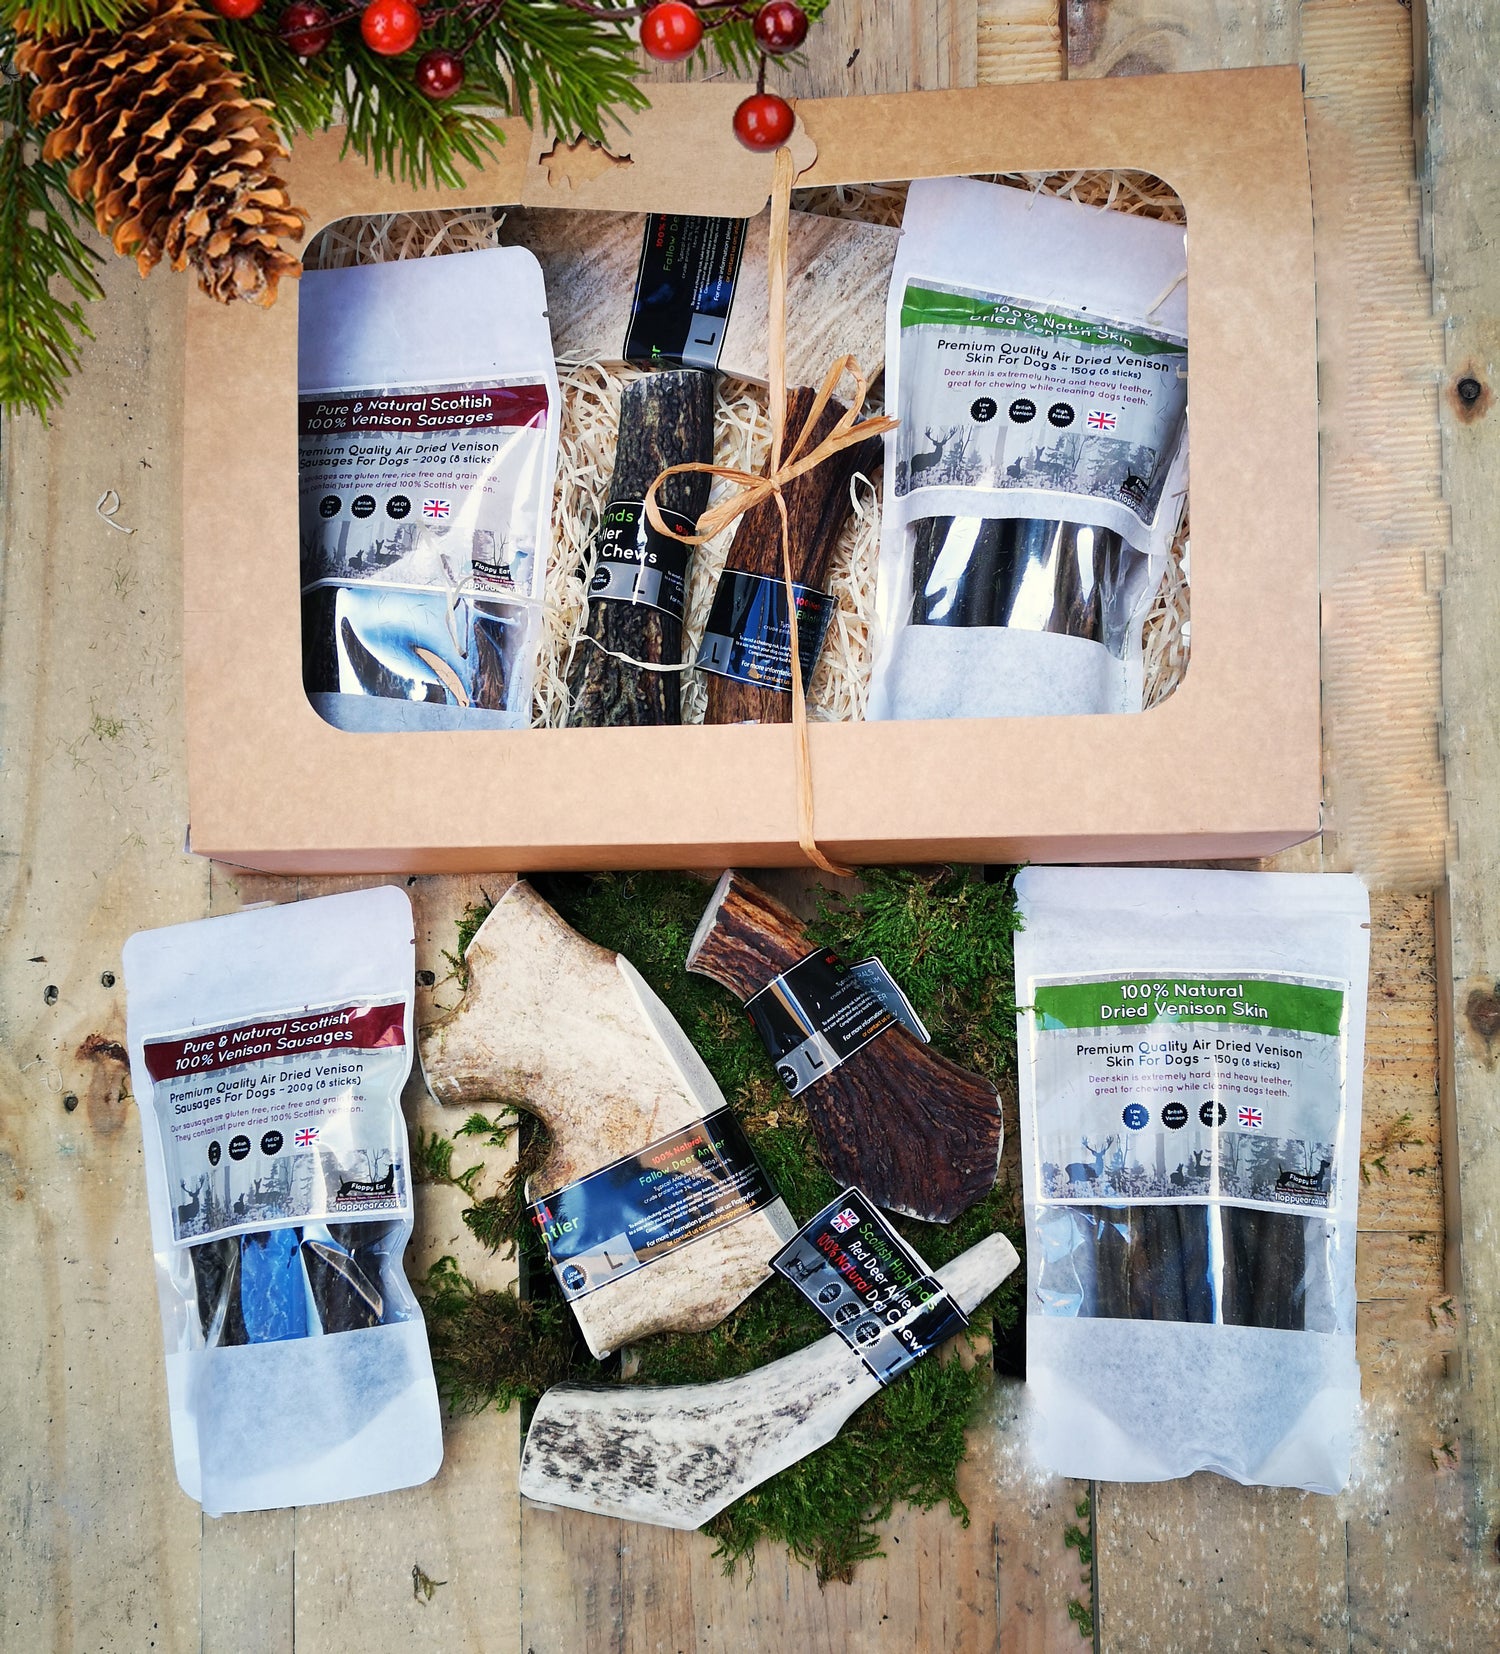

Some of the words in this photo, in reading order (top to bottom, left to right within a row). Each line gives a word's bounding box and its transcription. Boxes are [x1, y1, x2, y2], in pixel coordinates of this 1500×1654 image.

[664, 236, 675, 271] Fallow
[720, 240, 729, 274] information
[994, 305, 1038, 323] 100%
[694, 333, 716, 345] L
[1097, 329, 1132, 346] Skin
[938, 340, 996, 352] Premium
[1001, 343, 1048, 359] Quality
[1052, 350, 1070, 362] Air
[1075, 356, 1112, 365] Dried
[1117, 356, 1169, 372] Venison
[966, 352, 993, 364] Skin
[998, 354, 1019, 364] For
[1024, 356, 1056, 370] Dogs
[1071, 366, 1096, 376] 150g
[1112, 369, 1142, 380] sticks)
[944, 368, 964, 376] Deer
[997, 371, 1042, 380] extremely
[1044, 375, 1066, 384] hard
[1088, 380, 1116, 390] heavy
[1120, 384, 1152, 397] teether,
[948, 380, 971, 388] great
[988, 381, 1026, 390] chewing
[1030, 383, 1054, 392] while
[1056, 386, 1095, 398] cleaning
[1098, 390, 1120, 401] dogs
[1123, 395, 1148, 406] teeth.
[316, 404, 349, 416] Pure
[353, 402, 363, 413] &
[368, 398, 427, 412] Natural
[430, 394, 492, 411] Scottish
[307, 418, 346, 429] 100%
[352, 413, 412, 426] Venison
[416, 412, 494, 426] Sausages
[348, 444, 392, 456] Quality
[396, 446, 412, 454] Air
[416, 443, 448, 454] Dried
[451, 442, 500, 452] Venison
[300, 458, 354, 470] Sausages
[356, 456, 376, 466] For
[378, 456, 410, 468] Dogs
[420, 455, 446, 464] 200g
[450, 454, 459, 464] (8
[338, 482, 354, 490] just
[376, 481, 397, 489] dried
[400, 480, 422, 488] 100%
[423, 480, 458, 490] Scottish
[354, 472, 379, 482] gluten
[382, 472, 400, 480] free,
[455, 472, 478, 480] grain
[602, 543, 658, 564] Chews
[474, 562, 497, 574] Floppy
[712, 642, 720, 664] L
[1120, 983, 1170, 1000] 100%
[1174, 983, 1244, 998] Natural
[1101, 1002, 1148, 1019] Dried
[1154, 1002, 1226, 1016] Venison
[1232, 1002, 1268, 1018] Skin
[184, 1040, 215, 1054] Pure
[218, 1036, 228, 1048] &
[232, 1024, 287, 1044] Natural
[290, 1012, 350, 1032] Scottish
[842, 1032, 852, 1041] For
[850, 1026, 863, 1035] more
[862, 1009, 884, 1026] information
[867, 1021, 882, 1033] contact
[176, 1053, 214, 1070] 100%
[218, 1042, 272, 1062] Venison
[276, 1031, 354, 1050] Sausages
[804, 1050, 824, 1070] L
[1076, 1044, 1134, 1056] Premium
[1138, 1040, 1188, 1054] Quality
[1192, 1040, 1211, 1050] Air
[1216, 1040, 1251, 1052] Dried
[1256, 1042, 1302, 1060] Venison
[1106, 1056, 1134, 1068] Skin
[1139, 1055, 1160, 1066] For
[1165, 1054, 1200, 1067] Dogs
[1214, 1054, 1239, 1067] 150g
[1242, 1058, 1250, 1067] (8
[1253, 1060, 1280, 1070] sticks)
[170, 1086, 213, 1104] Premium
[216, 1078, 257, 1094] Quality
[260, 1073, 276, 1084] Air
[280, 1068, 312, 1082] Dried
[315, 1064, 364, 1077] Venison
[1088, 1075, 1110, 1083] Deer
[1112, 1074, 1130, 1082] skin
[1141, 1072, 1187, 1082] extremely
[1190, 1070, 1212, 1079] hard
[1234, 1072, 1258, 1082] heavy
[1260, 1075, 1293, 1087] teether,
[175, 1096, 222, 1116] Sausages
[224, 1092, 243, 1103] For
[246, 1087, 276, 1100] Dogs
[287, 1082, 314, 1094] 200g
[316, 1080, 326, 1090] (8
[328, 1076, 362, 1088] sticks)
[1095, 1086, 1118, 1096] great
[1120, 1085, 1132, 1094] for
[1136, 1084, 1174, 1094] chewing
[1177, 1082, 1200, 1091] while
[1243, 1086, 1264, 1096] dogs
[1266, 1087, 1290, 1098] teeth.
[170, 1124, 182, 1133] Our
[183, 1117, 214, 1130] sausages
[225, 1108, 250, 1120] gluten
[252, 1106, 270, 1115] free,
[288, 1101, 304, 1110] free
[306, 1098, 321, 1106] and
[176, 1133, 192, 1143] They
[192, 1127, 216, 1138] contain
[228, 1121, 246, 1130] pure
[248, 1116, 269, 1126] dried
[270, 1112, 292, 1122] 100%
[294, 1108, 325, 1120] Scottish
[652, 1150, 673, 1164] 100%
[674, 1136, 703, 1154] Natural
[639, 1167, 670, 1186] Fallow
[672, 1154, 695, 1169] Deer
[1290, 1174, 1309, 1186] Floppy
[351, 1182, 374, 1192] Floppy
[1275, 1192, 1328, 1206] floppyear.co.uk
[656, 1233, 669, 1242] more
[669, 1220, 698, 1236] information
[698, 1211, 714, 1223] please
[673, 1233, 691, 1243] contact
[859, 1223, 893, 1261] Scottish
[604, 1251, 623, 1270] L
[817, 1232, 841, 1257] 100%
[835, 1252, 872, 1293] Natural
[848, 1240, 869, 1261] Red
[863, 1257, 889, 1285] Deer
